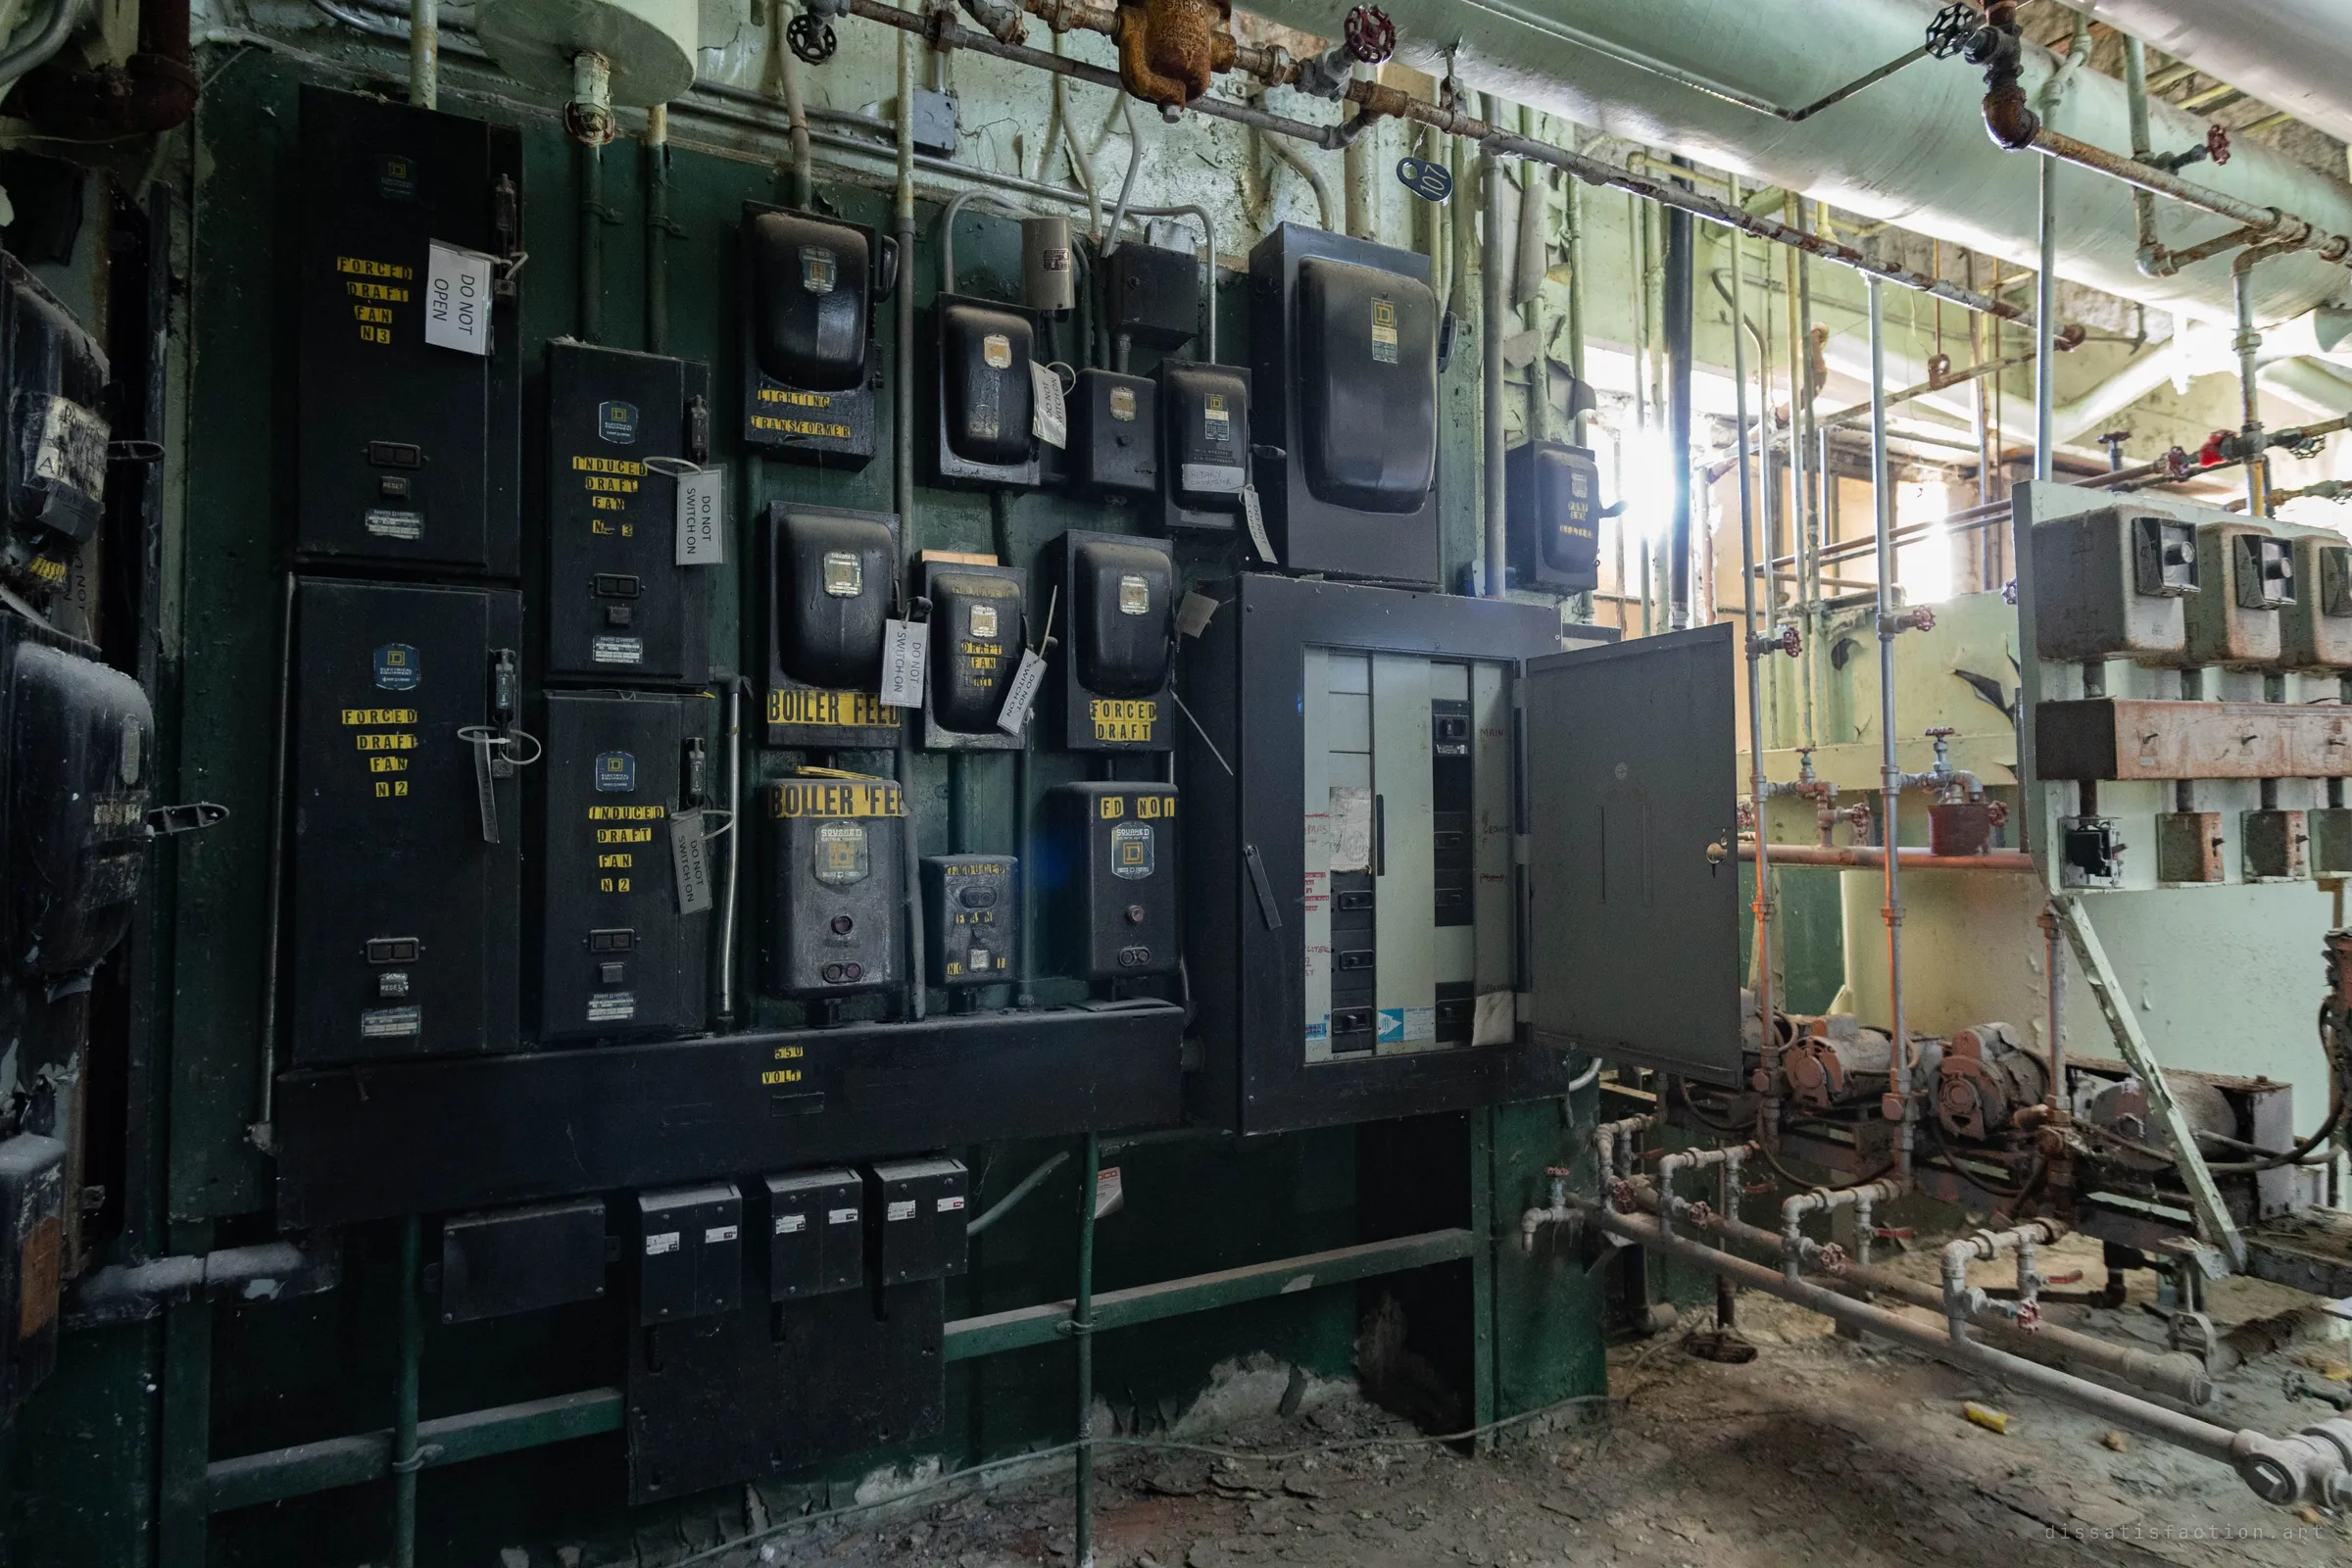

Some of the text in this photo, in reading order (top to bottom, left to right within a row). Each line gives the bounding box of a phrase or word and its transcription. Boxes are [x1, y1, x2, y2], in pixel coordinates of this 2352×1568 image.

[1165, 0, 1205, 19] SARCO
[1420, 164, 1448, 197] 107
[338, 258, 412, 280] FORCED
[348, 281, 408, 302] DRAFT
[432, 277, 449, 321] OPEN
[458, 273, 475, 336] DO NOT
[356, 306, 391, 323] FAN
[1042, 380, 1052, 402] NOT
[1051, 376, 1058, 392] ON
[759, 390, 830, 408] LIGHTING
[752, 416, 851, 437] TRANSFORMER
[574, 457, 647, 475] INDUCED
[381, 481, 405, 490] RESET
[586, 477, 636, 491] DRAFT
[594, 498, 625, 510] FAN
[687, 488, 697, 555] SWITCH ON
[702, 496, 711, 542] DO NOT
[894, 632, 906, 693] SWITCH ON
[909, 642, 922, 684] DO NOT
[972, 657, 996, 668] FAN
[1005, 662, 1032, 717] SWITCH ON
[1016, 674, 1036, 711] DO NOT
[344, 710, 416, 723] FORCED
[768, 690, 900, 725] BOILER FEED
[1091, 701, 1156, 718] FORCED
[1098, 723, 1150, 740] DRAFT
[359, 735, 417, 748] DRAFT
[373, 758, 408, 771] FAN
[397, 782, 406, 795] 2
[772, 784, 854, 815] BOILER
[1103, 799, 1122, 816] FD
[1139, 798, 1157, 816] NO
[590, 807, 662, 819] INDUCED
[599, 828, 650, 842] DRAFT
[602, 855, 630, 867] FAN
[678, 835, 694, 903] SWITCH ON
[690, 840, 705, 886] DO NOT
[619, 879, 628, 891] 2
